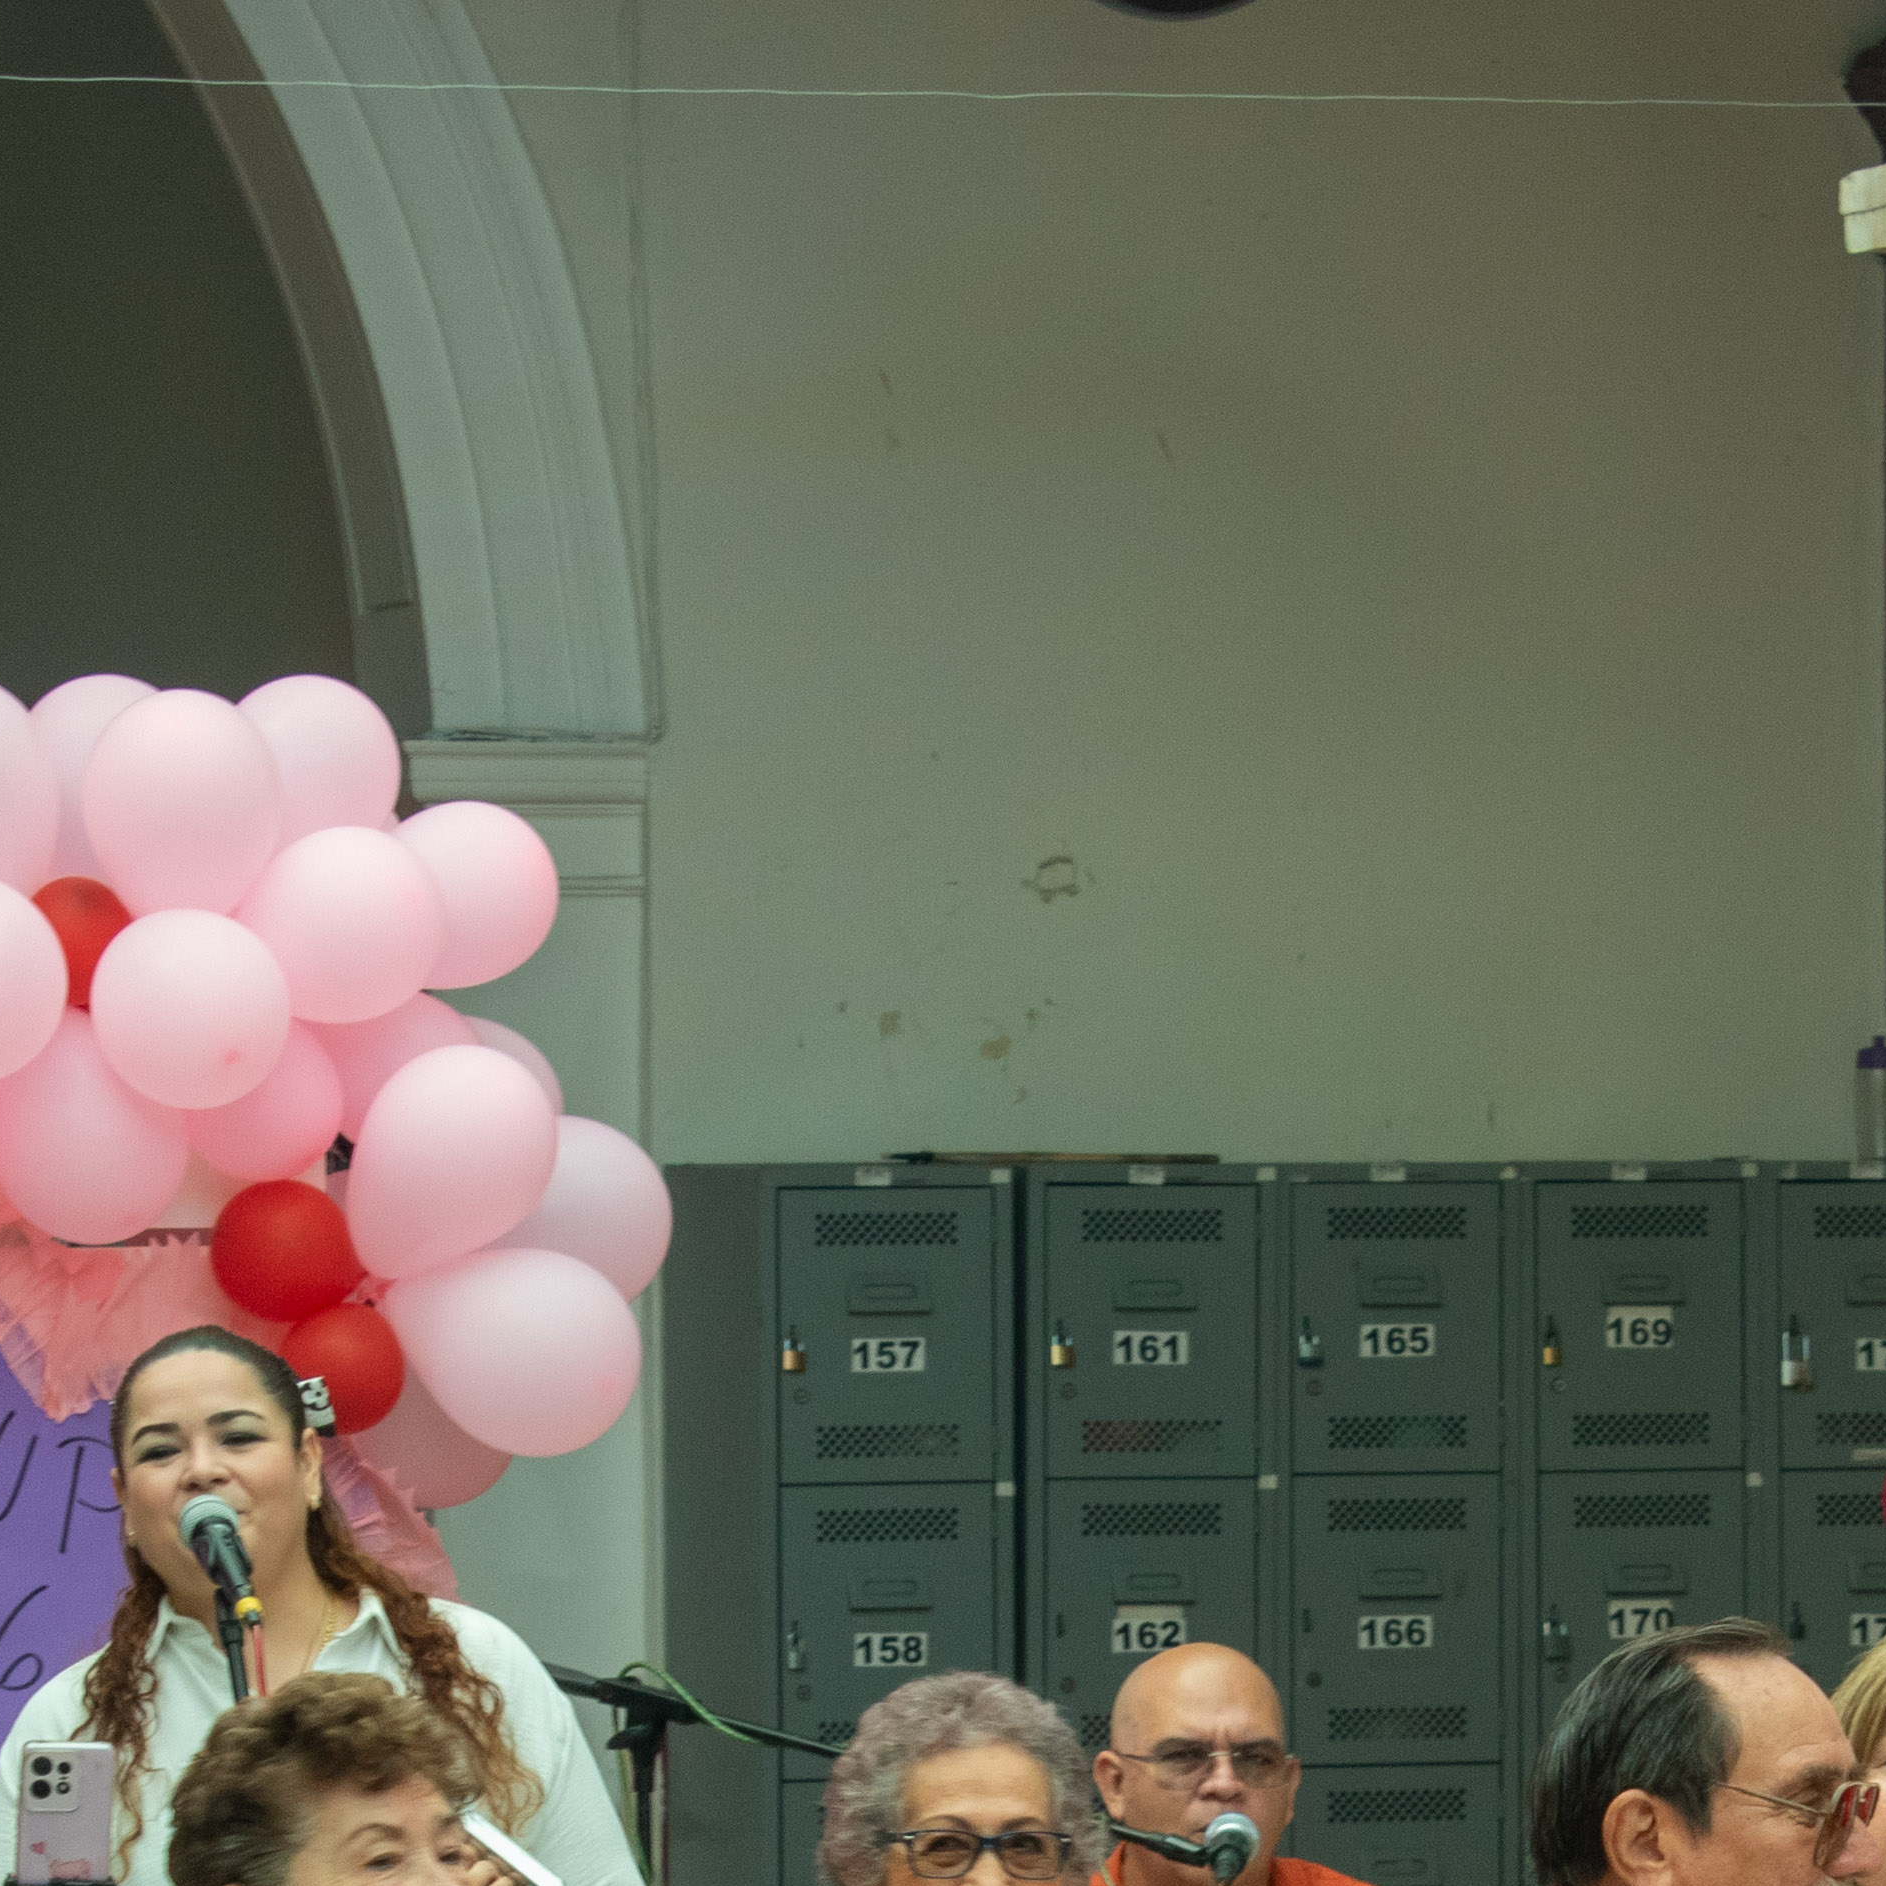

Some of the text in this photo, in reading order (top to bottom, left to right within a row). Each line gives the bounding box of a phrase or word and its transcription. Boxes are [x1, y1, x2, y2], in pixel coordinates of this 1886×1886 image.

[1363, 1326, 1430, 1355] 165
[1607, 1317, 1673, 1346] 169
[852, 1340, 921, 1370] 157
[1116, 1335, 1180, 1363] 161
[1116, 1621, 1182, 1650] 162
[1360, 1618, 1427, 1647] 166
[1609, 1608, 1674, 1636] 170
[856, 1635, 924, 1664] 158
